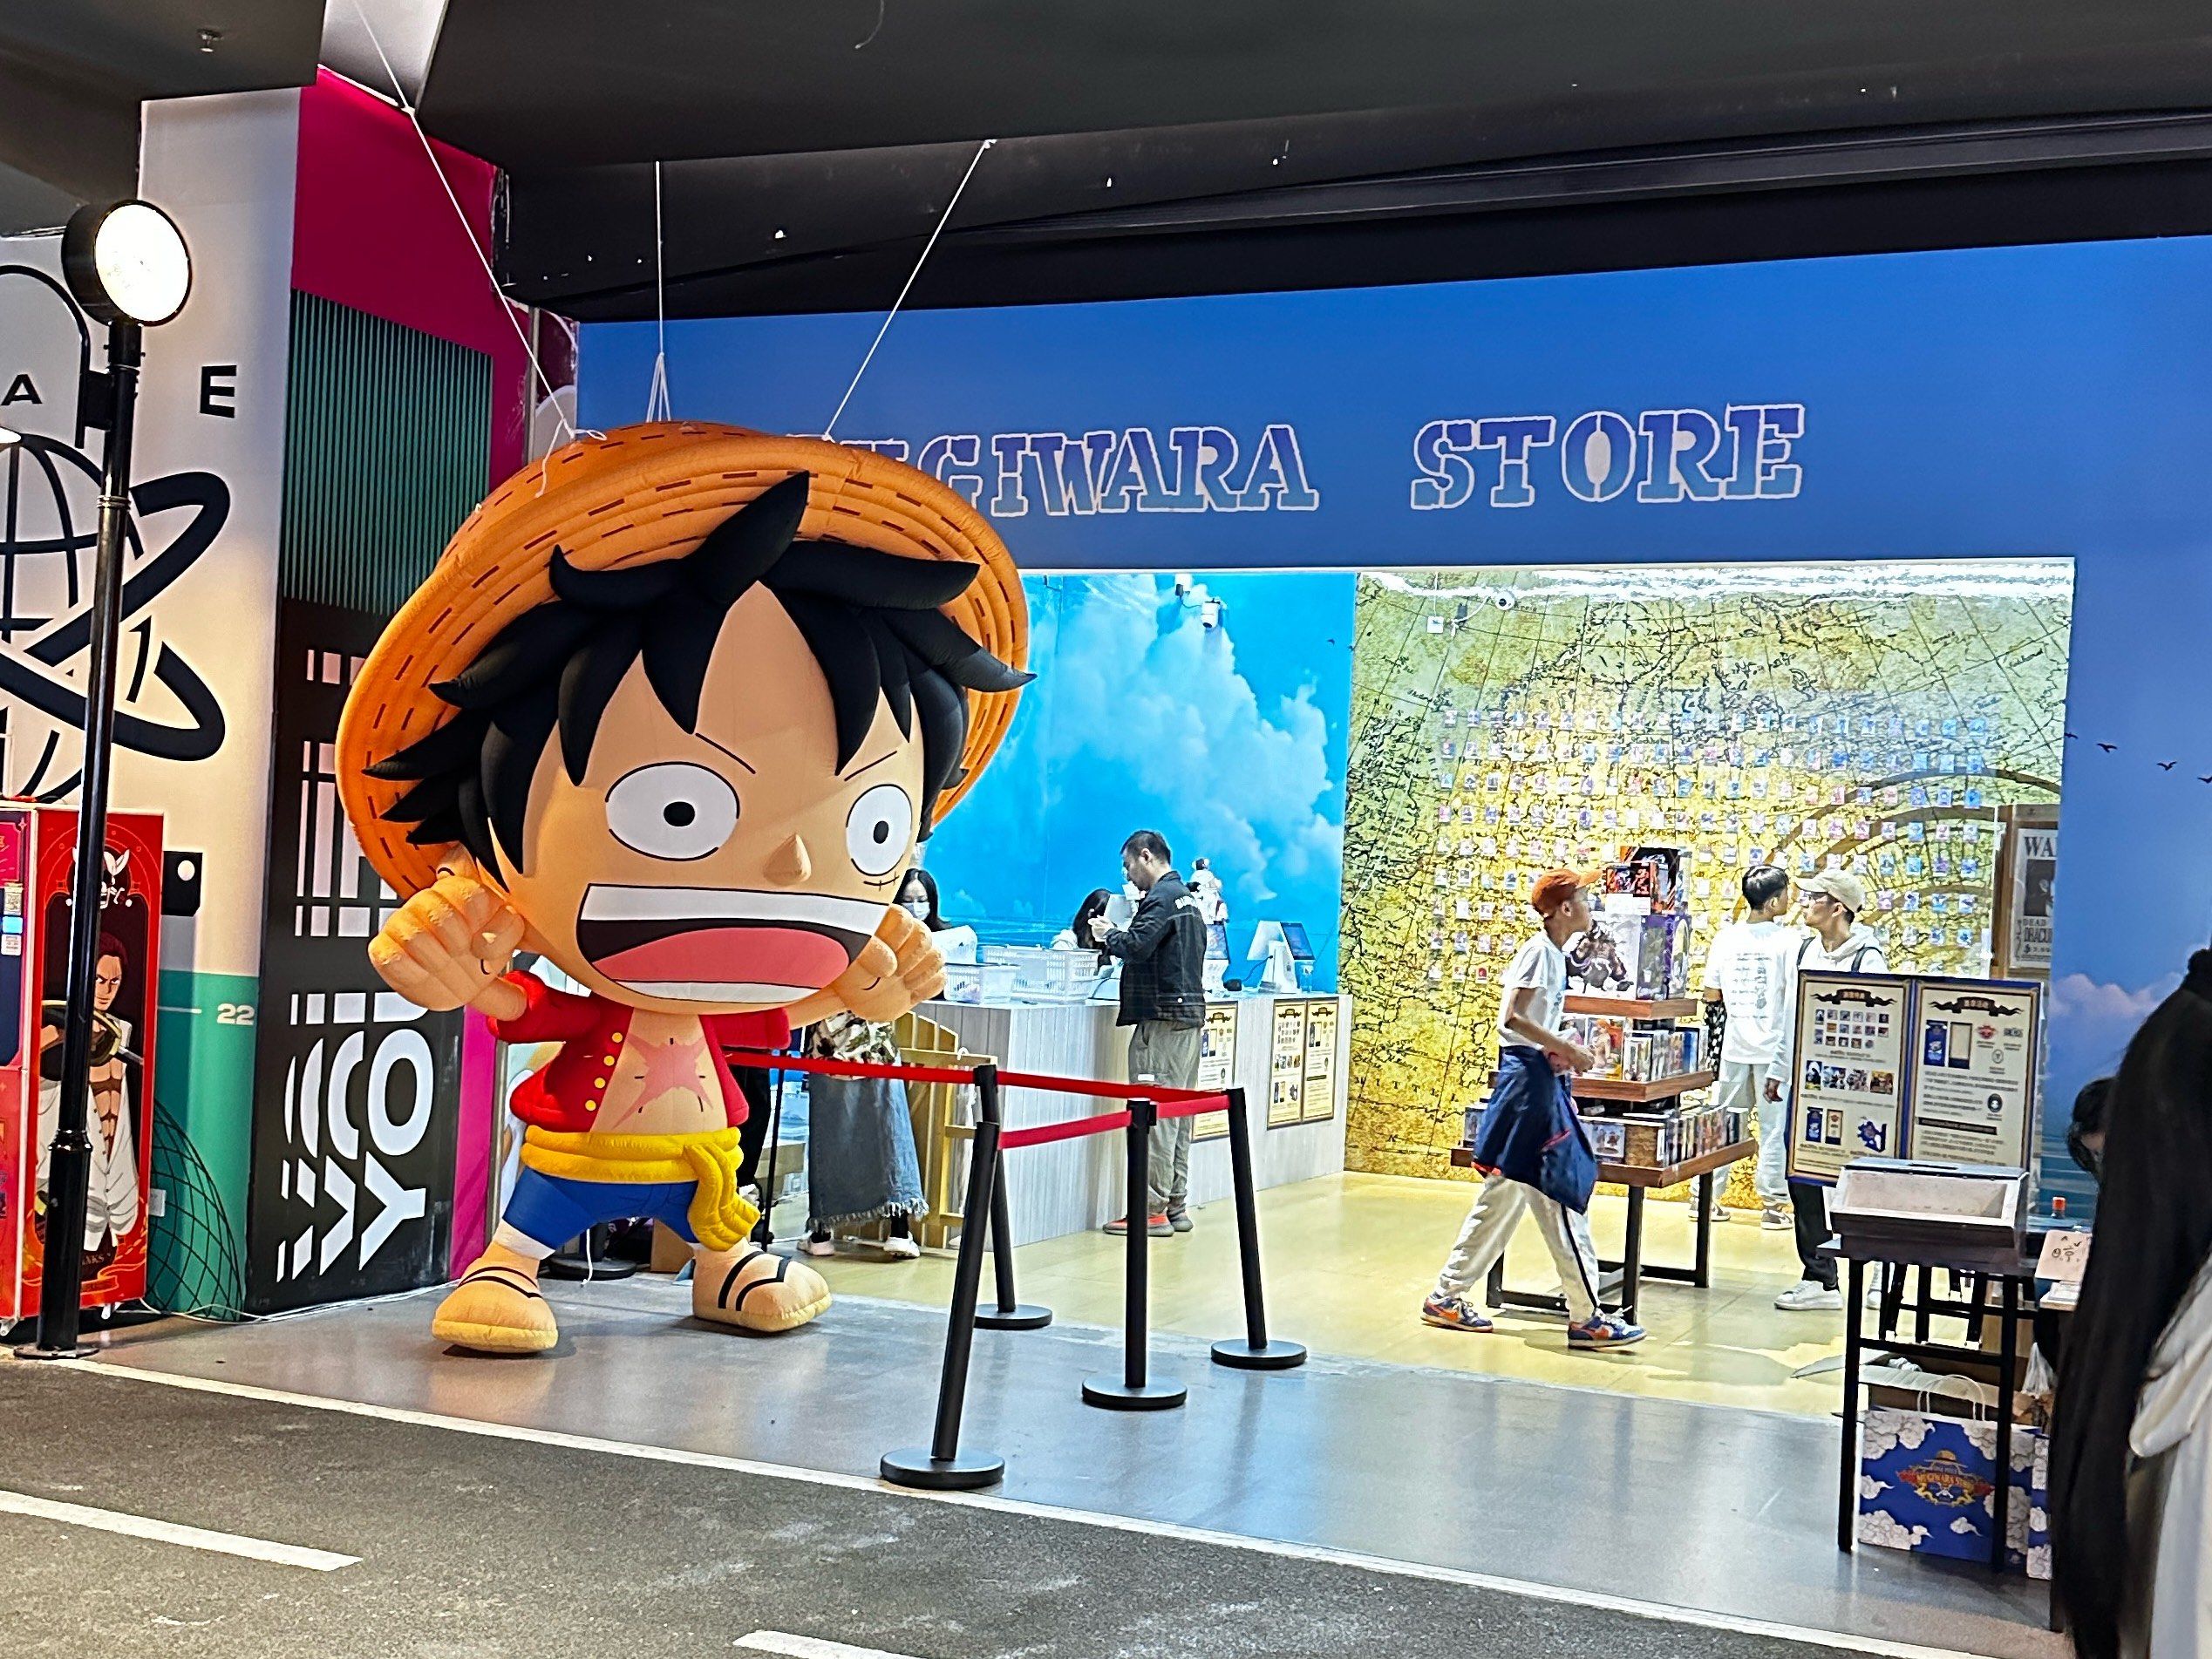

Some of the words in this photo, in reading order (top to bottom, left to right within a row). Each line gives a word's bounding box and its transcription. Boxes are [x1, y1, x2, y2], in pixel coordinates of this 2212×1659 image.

[785, 425, 1319, 517] GIWARA
[1411, 403, 1805, 510] STORE
[2024, 836, 2058, 857] WA
[217, 1003, 255, 1026] 22
